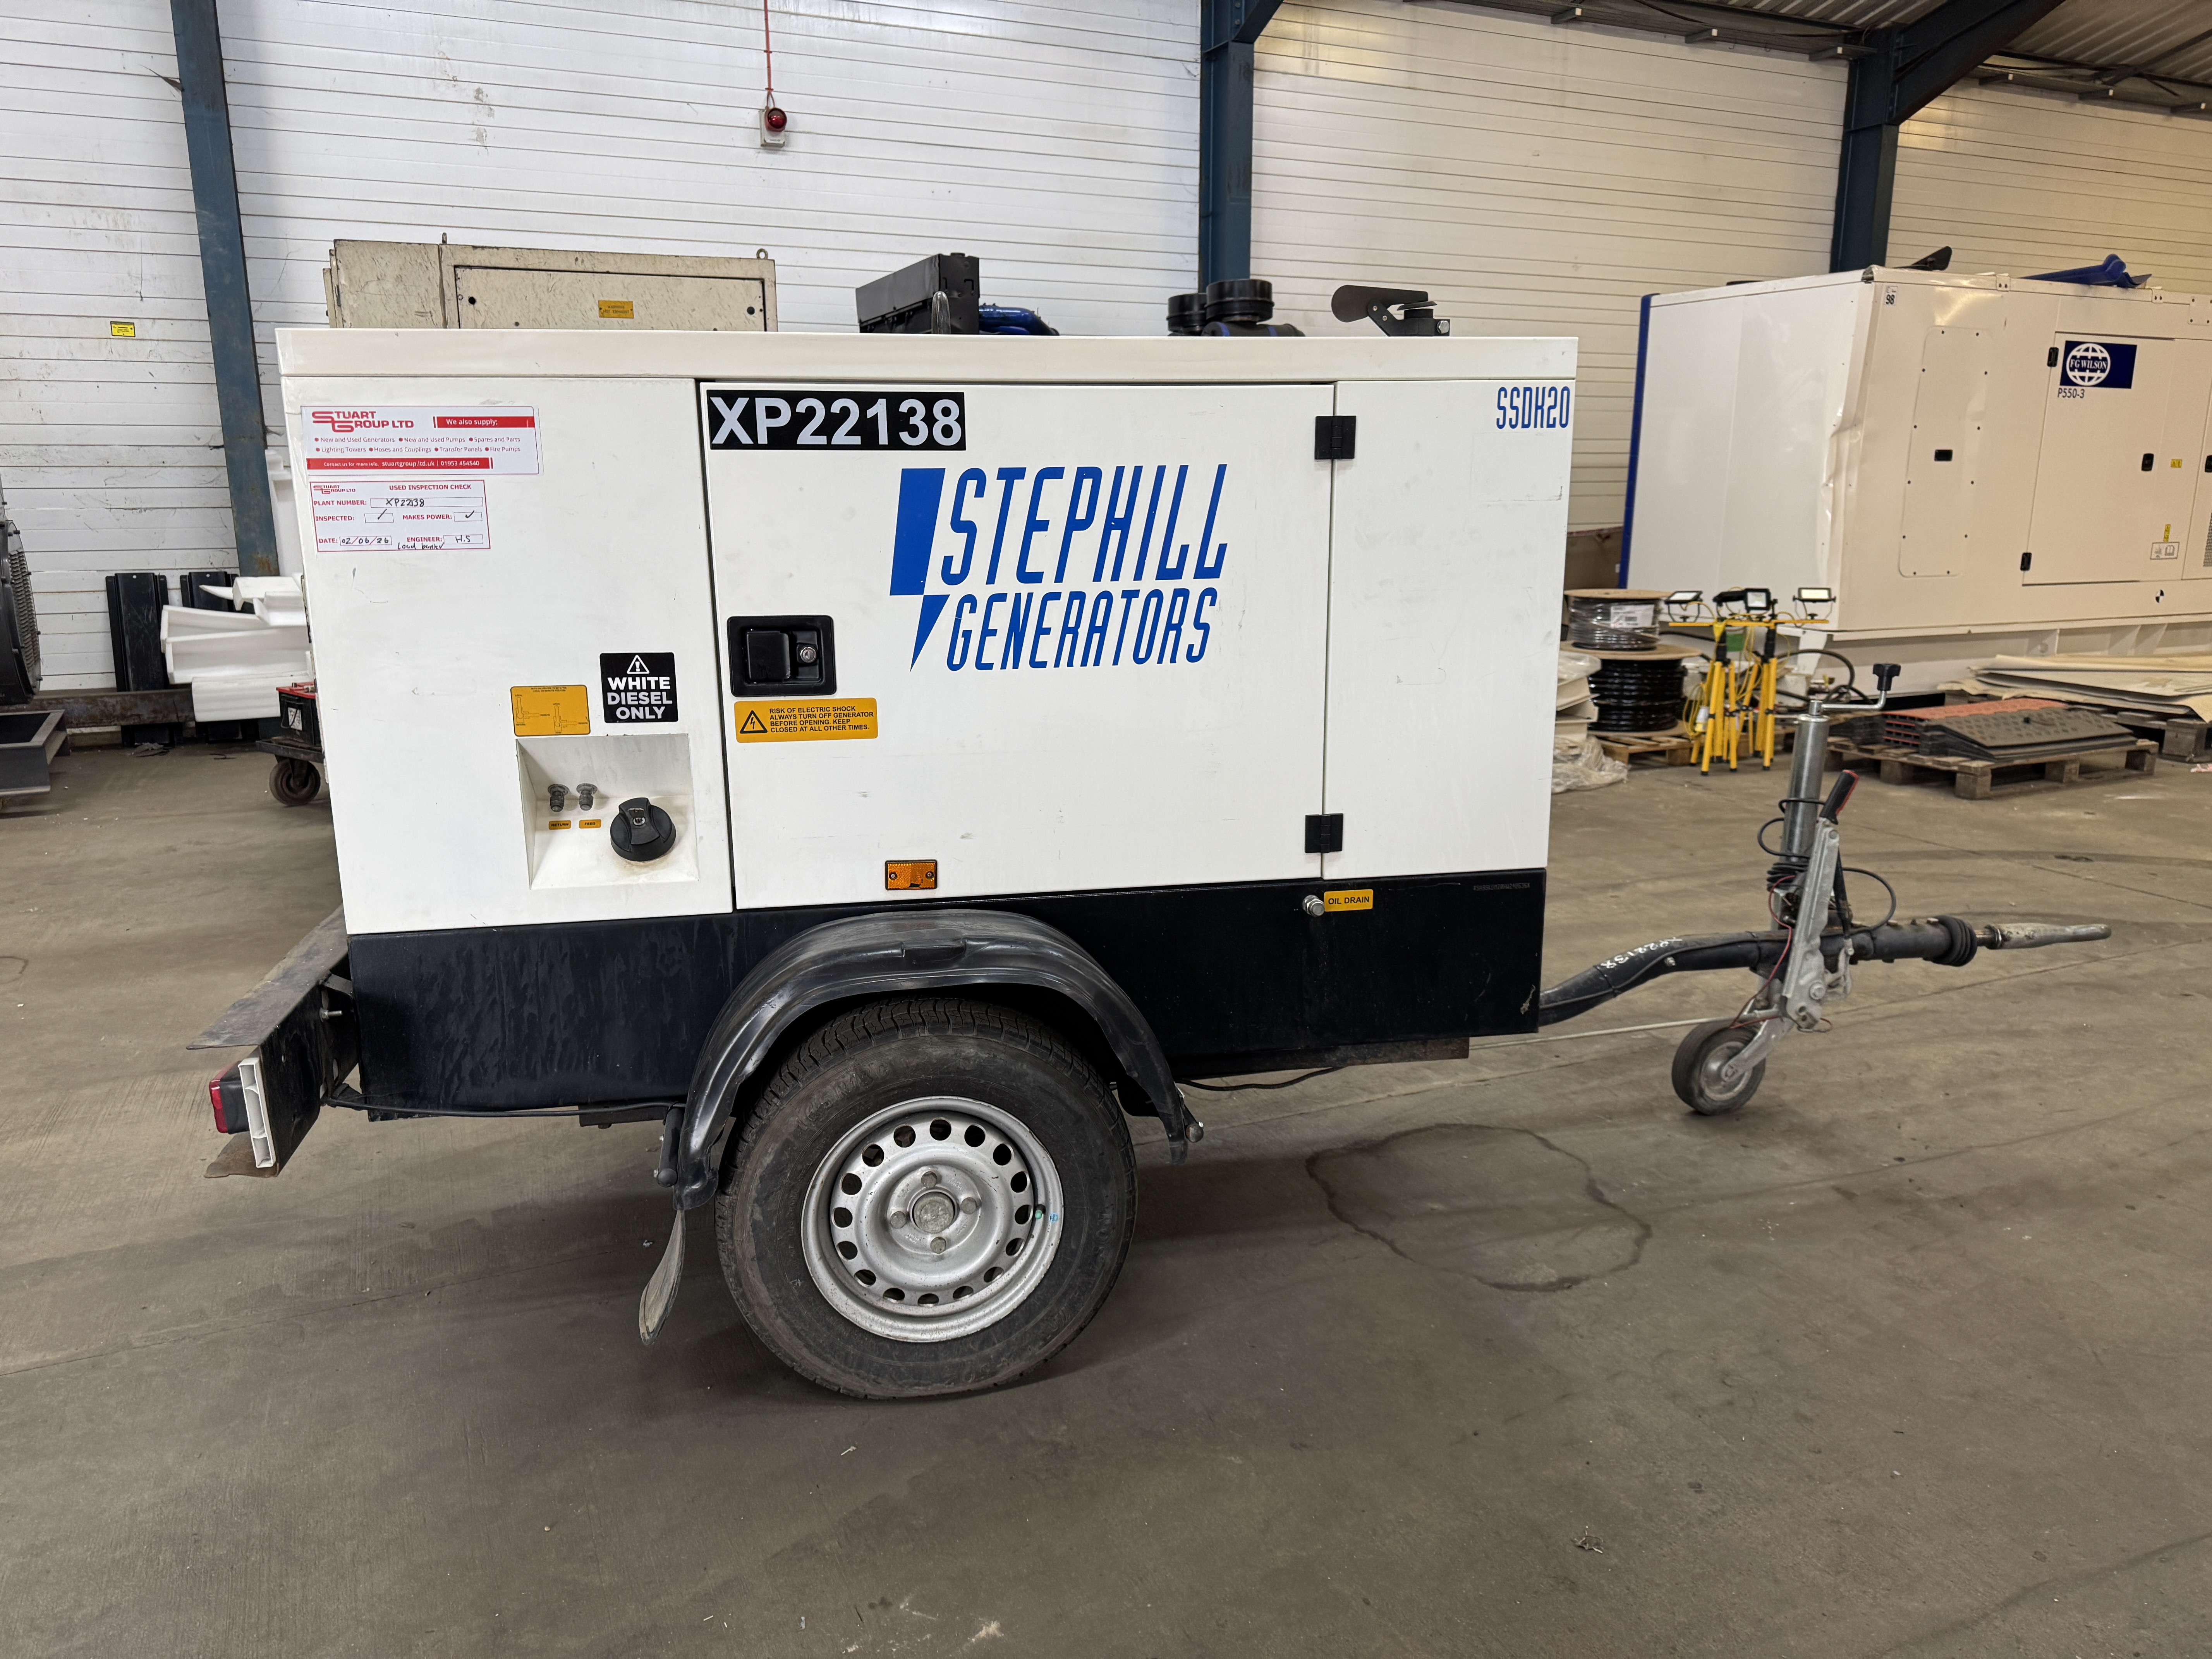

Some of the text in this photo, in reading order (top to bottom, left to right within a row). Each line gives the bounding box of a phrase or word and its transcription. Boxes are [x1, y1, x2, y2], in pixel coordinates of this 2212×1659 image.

[1885, 294, 1895, 305] 98
[2070, 359, 2107, 369] FG WILSON
[2057, 387, 2085, 398] P550-3
[1496, 386, 1570, 429] SSDK20
[312, 411, 376, 423] STUART
[710, 397, 962, 447] XP22138
[331, 420, 389, 433] GROUP
[385, 497, 425, 507] XP22138
[941, 464, 1228, 586] STEPHILL
[946, 587, 1218, 672] GENERATORS
[607, 677, 670, 690] WHITE
[607, 691, 673, 705] DIESEL
[616, 706, 666, 720] ONLY
[1344, 896, 1370, 904] DRAIN
